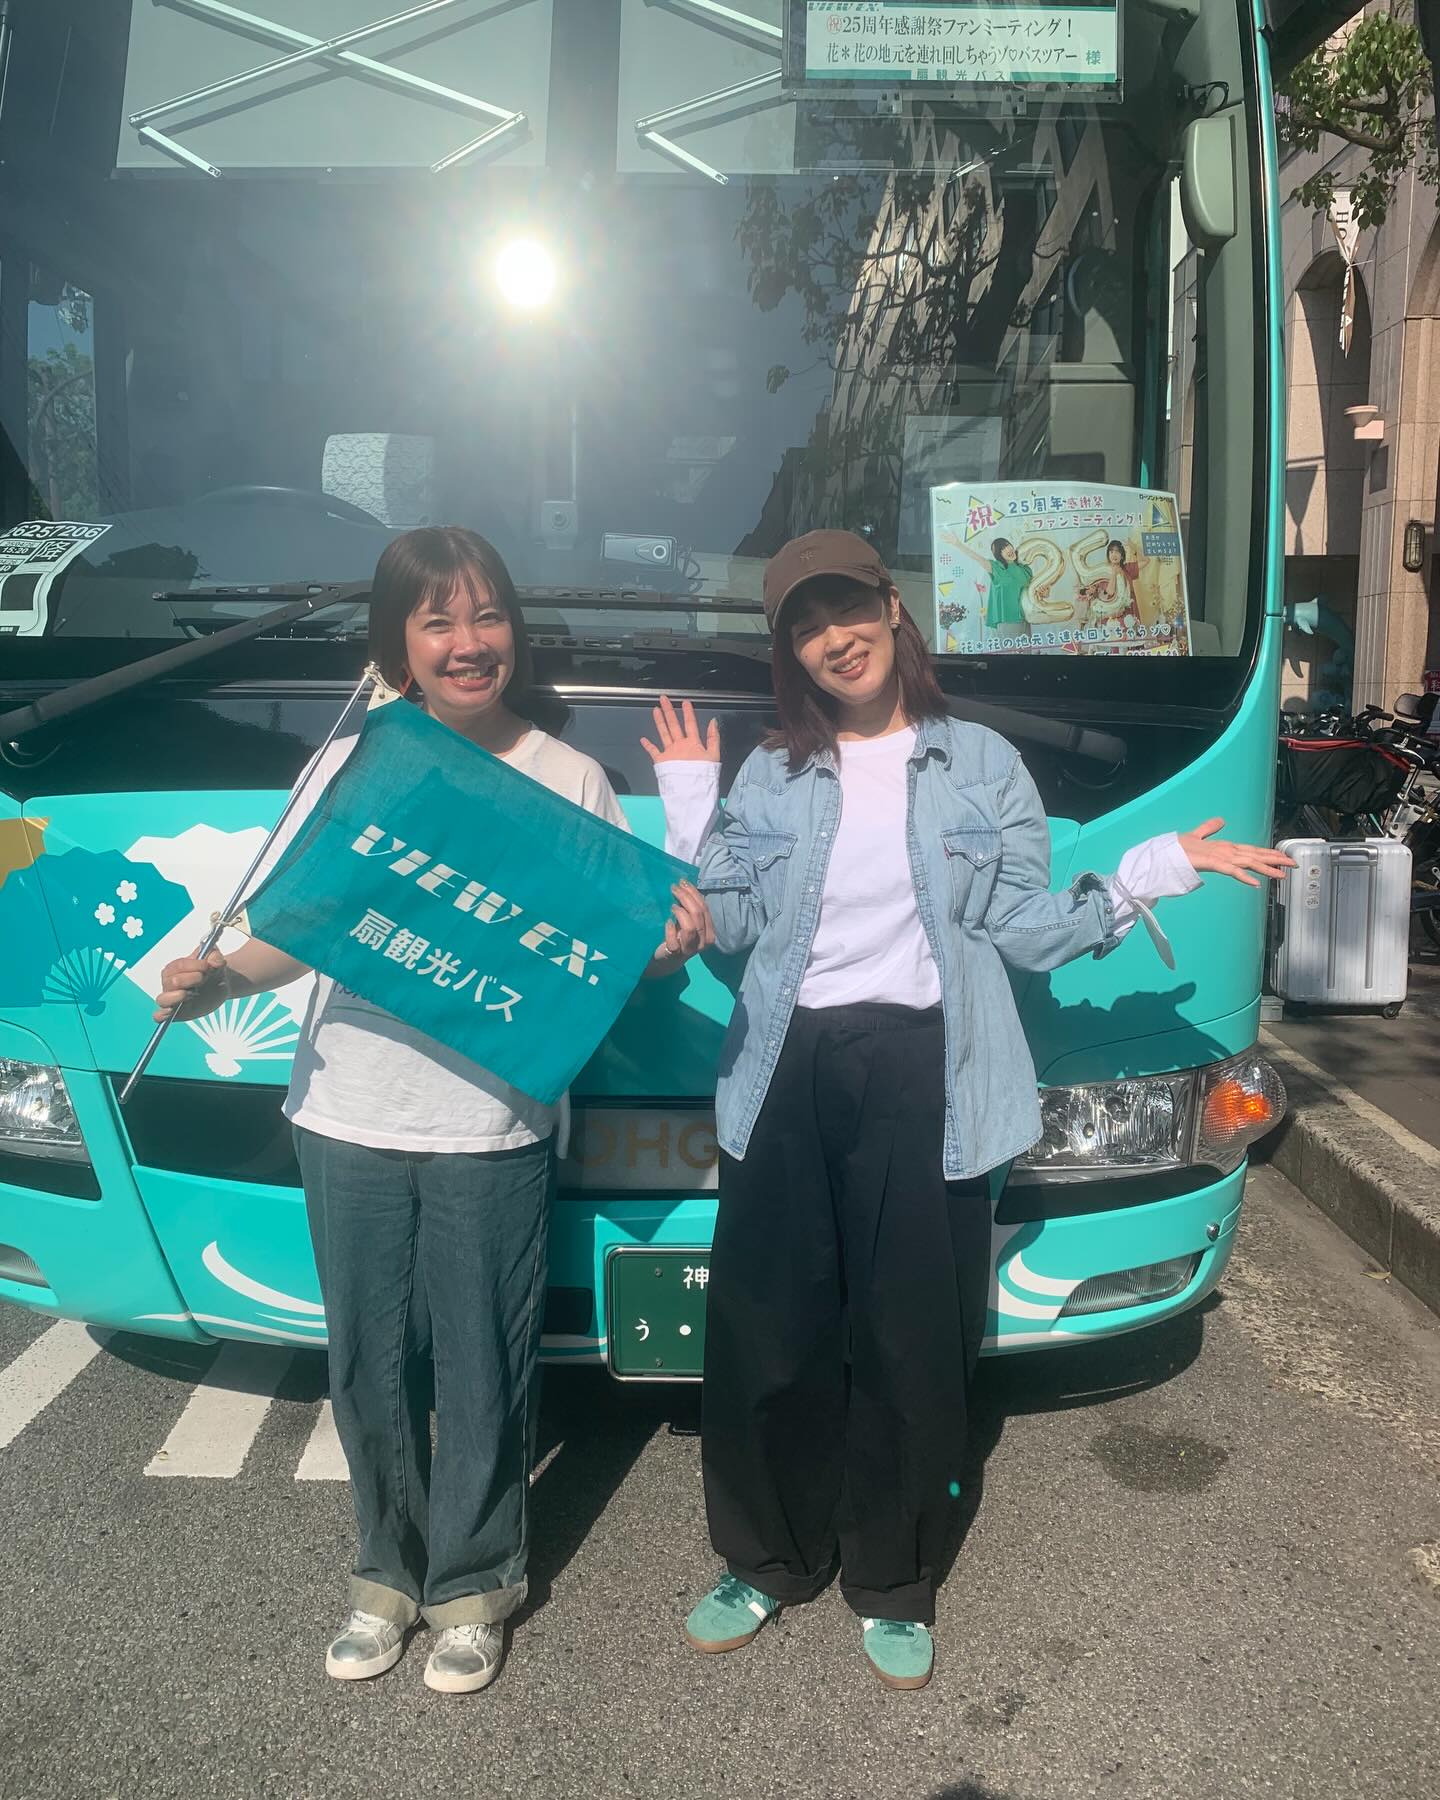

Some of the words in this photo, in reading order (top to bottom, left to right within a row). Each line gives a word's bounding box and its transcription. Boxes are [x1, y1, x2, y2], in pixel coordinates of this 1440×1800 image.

[1085, 49, 1102, 65] 様
[1008, 496, 1104, 514] 25周年感謝祭
[967, 503, 998, 531] 祝
[29, 540, 72, 561] 降
[351, 824, 523, 923] VIEW
[350, 908, 523, 1023] 扇観光バス
[683, 1265, 710, 1289] 神
[634, 1318, 650, 1341] う
